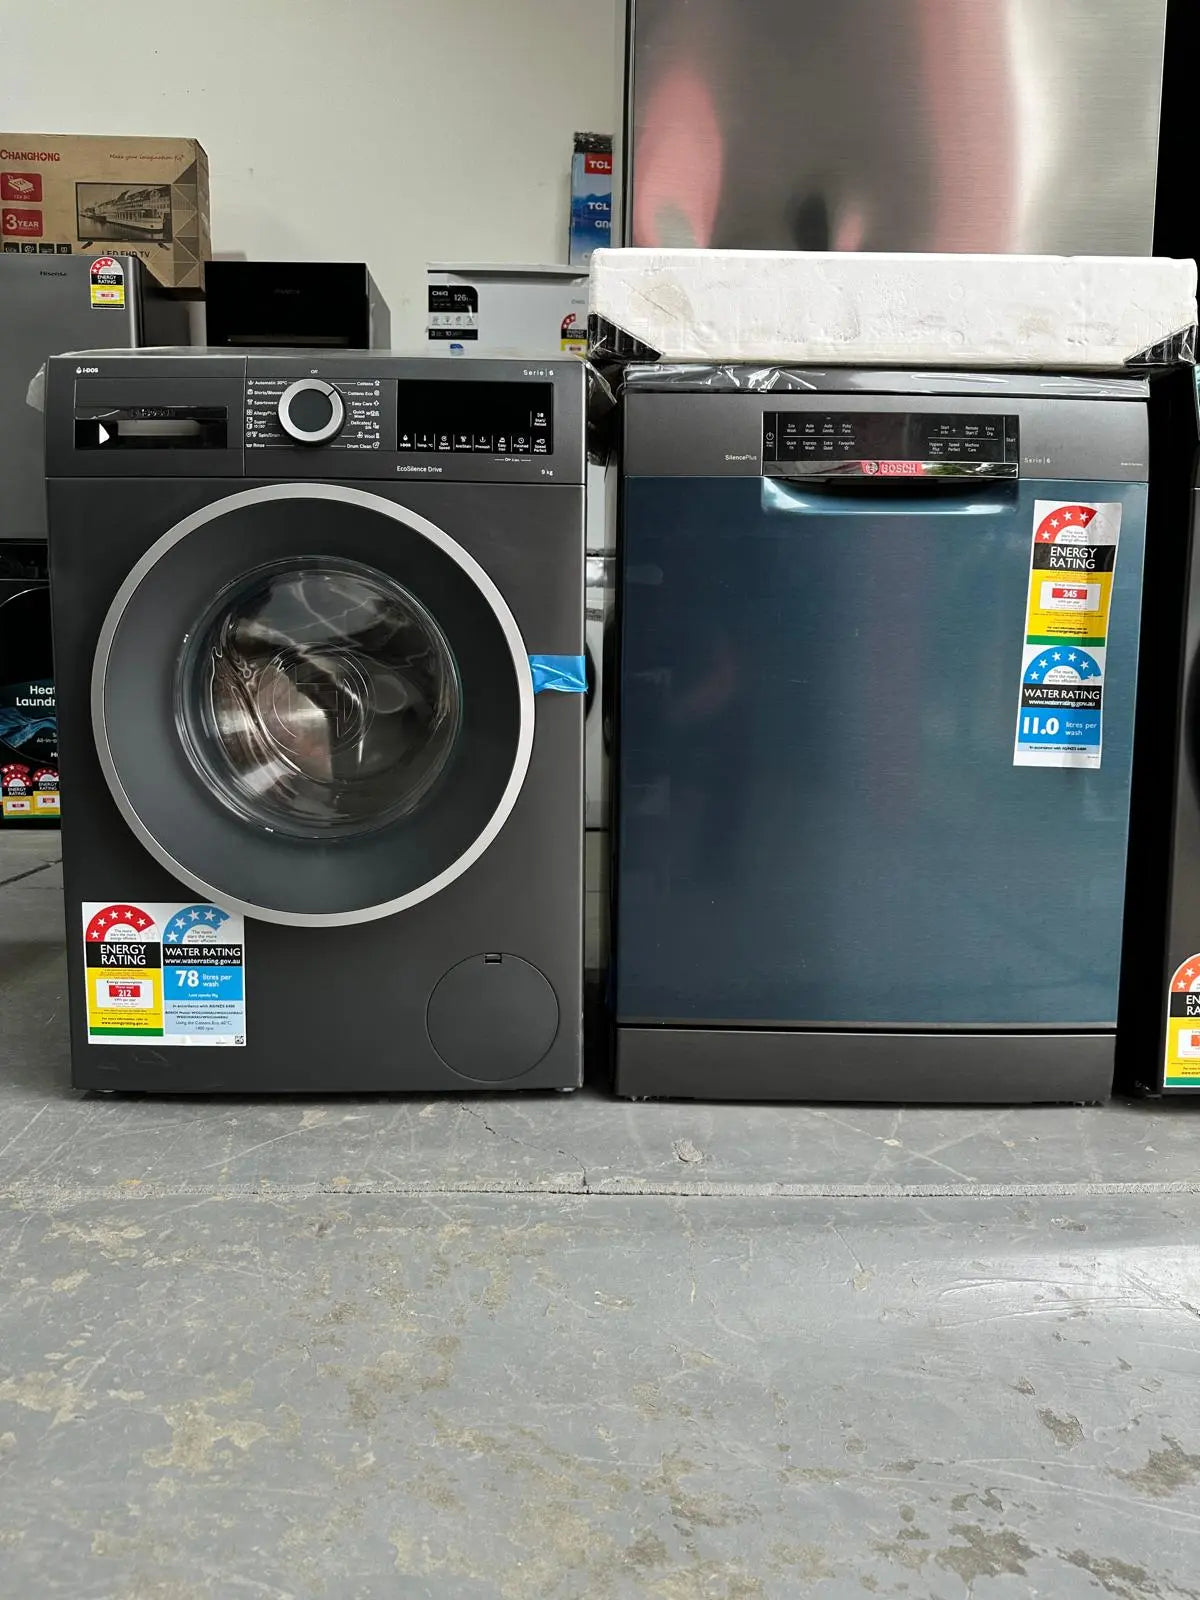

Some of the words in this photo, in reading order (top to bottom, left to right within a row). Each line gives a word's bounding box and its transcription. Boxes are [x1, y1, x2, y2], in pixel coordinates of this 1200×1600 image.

[0, 149, 60, 162] CHANGHONG
[589, 160, 611, 169] TCL
[588, 202, 610, 210] TCL
[6, 214, 18, 230] 3
[17, 220, 39, 228] YEAR
[139, 250, 150, 258] TV
[881, 463, 916, 473] BOSCH
[1050, 546, 1098, 558] ENERGY
[1049, 558, 1096, 569] RATING
[1063, 590, 1078, 598] 245
[1024, 688, 1059, 699] WATER
[1061, 690, 1100, 700] RATING
[1028, 700, 1096, 708] www.waterrating.gov.au
[1023, 716, 1060, 735] 11.0
[1085, 722, 1097, 730] per
[100, 944, 146, 954] ENERGY
[165, 948, 200, 957] WATER
[202, 948, 241, 957] RATING
[101, 954, 146, 966] RATING
[164, 958, 241, 966] www.waterrating.gov.au
[175, 970, 200, 988] 78
[220, 974, 232, 982] per
[202, 980, 220, 988] wash
[118, 989, 132, 998] 212
[1186, 994, 1200, 1005] EN
[1186, 1006, 1200, 1016] RA
